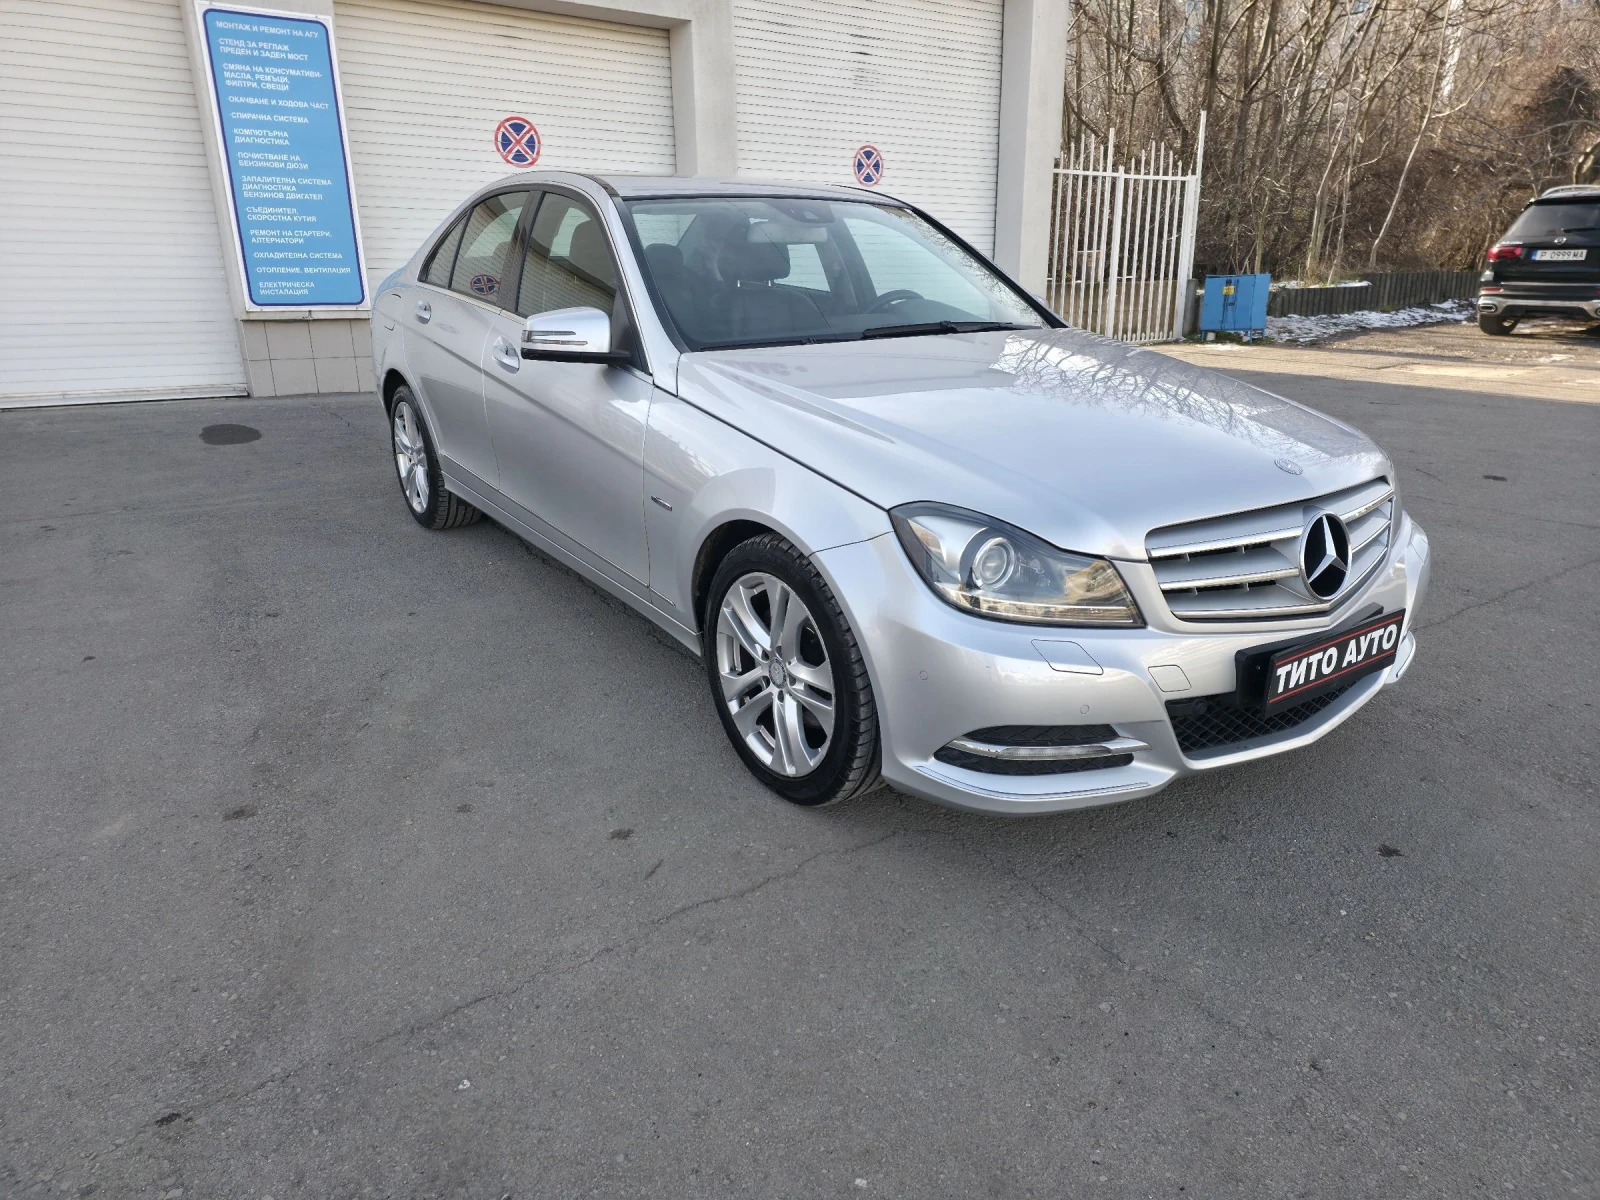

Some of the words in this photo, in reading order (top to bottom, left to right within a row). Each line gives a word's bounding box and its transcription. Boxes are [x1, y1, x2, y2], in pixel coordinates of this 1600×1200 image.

[216, 21, 251, 31] МОНТАЖ
[259, 25, 291, 35] РЕМОНТ
[292, 29, 303, 37] НА
[219, 37, 246, 48] СТЕНД
[246, 40, 257, 48] ЗА
[258, 41, 289, 51] РЕГЛАЖ
[220, 46, 252, 56] ПРЕДЕН
[260, 50, 286, 59] ЗАДЕН
[222, 63, 251, 71] СМЯНА
[265, 67, 323, 78] КОНСУМАТИВИ-
[260, 82, 289, 92] СВЕЩИ
[228, 95, 269, 105] ОКАЧВАНЕ
[278, 99, 310, 109] ХОДОВА
[310, 102, 330, 110] ЧАСТ
[231, 112, 272, 121] СПИРАЧНА
[273, 115, 309, 124] СИСТЕМА
[233, 127, 289, 138] КОМПЮТЪРНА
[234, 135, 290, 146] ДИАГНОСТИКА
[237, 151, 289, 161] ПОЧИСТВАНЕ
[238, 160, 285, 169] БЕНЗИНОВИ
[286, 162, 309, 170] ДЮЗИ
[241, 175, 297, 185] ЗАПАЛИТЕЛНА
[297, 178, 332, 186] СИСТЕМА
[242, 183, 297, 192] ДИАГНОСТИКА
[243, 191, 285, 200] БЕНЗИНОВ
[285, 193, 323, 201] ДВИГАТЕЛ
[1276, 646, 1338, 694] ТИТО
[1342, 624, 1397, 668] АУТО
